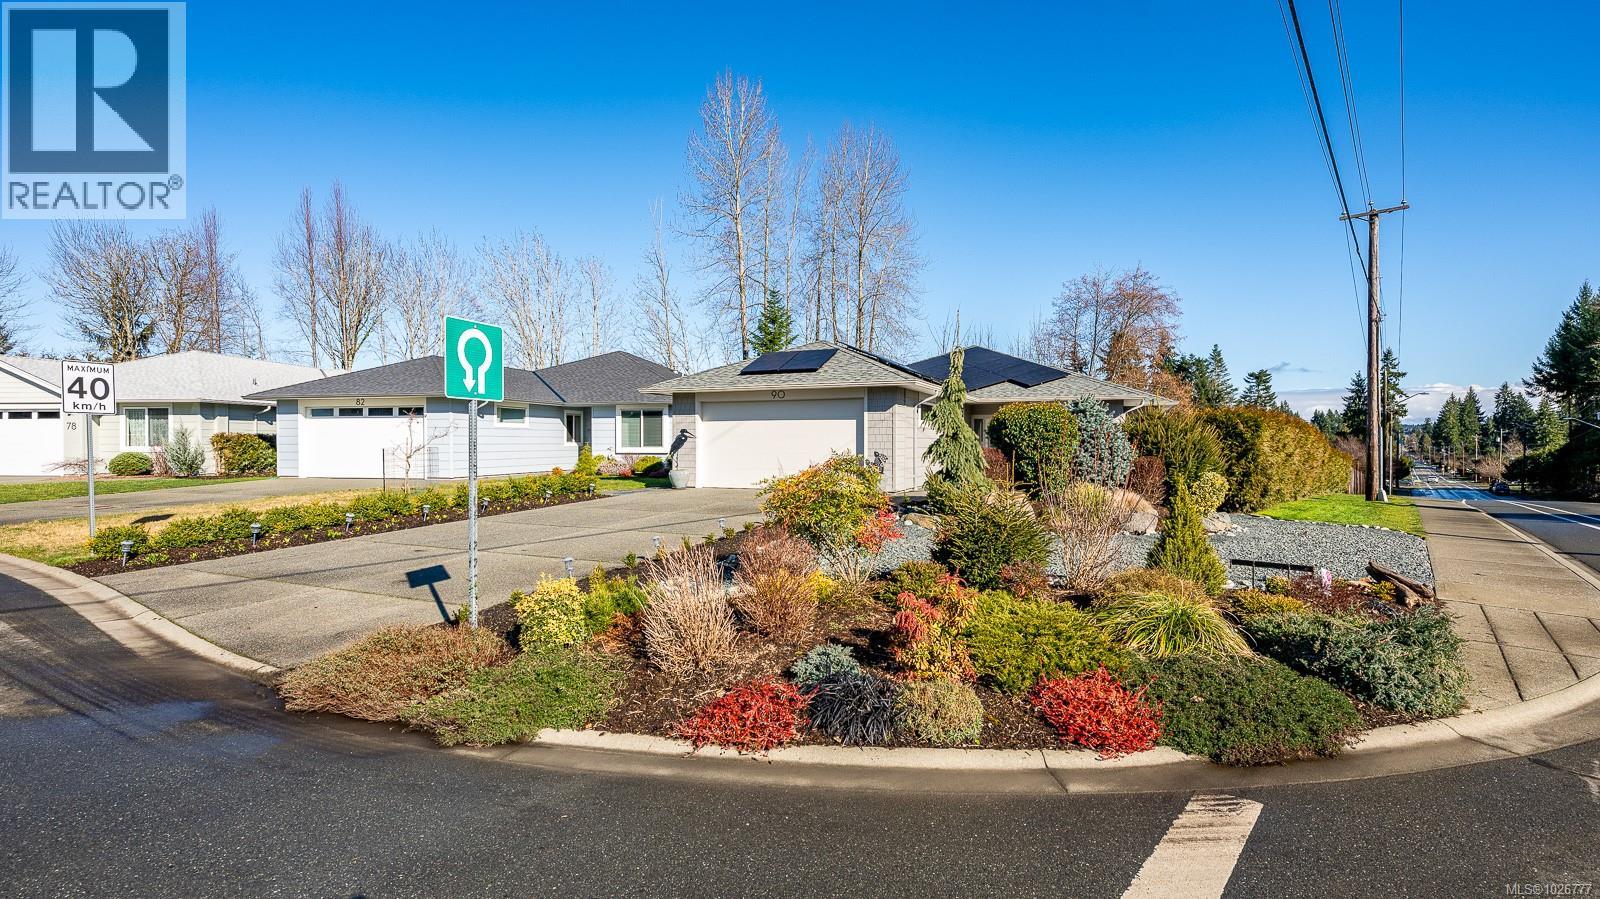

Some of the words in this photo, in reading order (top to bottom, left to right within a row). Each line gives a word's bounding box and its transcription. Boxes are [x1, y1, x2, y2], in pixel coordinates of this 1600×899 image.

[67, 364, 110, 374] MAXIMUM
[67, 376, 110, 401] 40
[770, 390, 786, 400] 90
[72, 401, 106, 411] km/h
[355, 398, 366, 406] 82
[66, 422, 77, 431] 78
